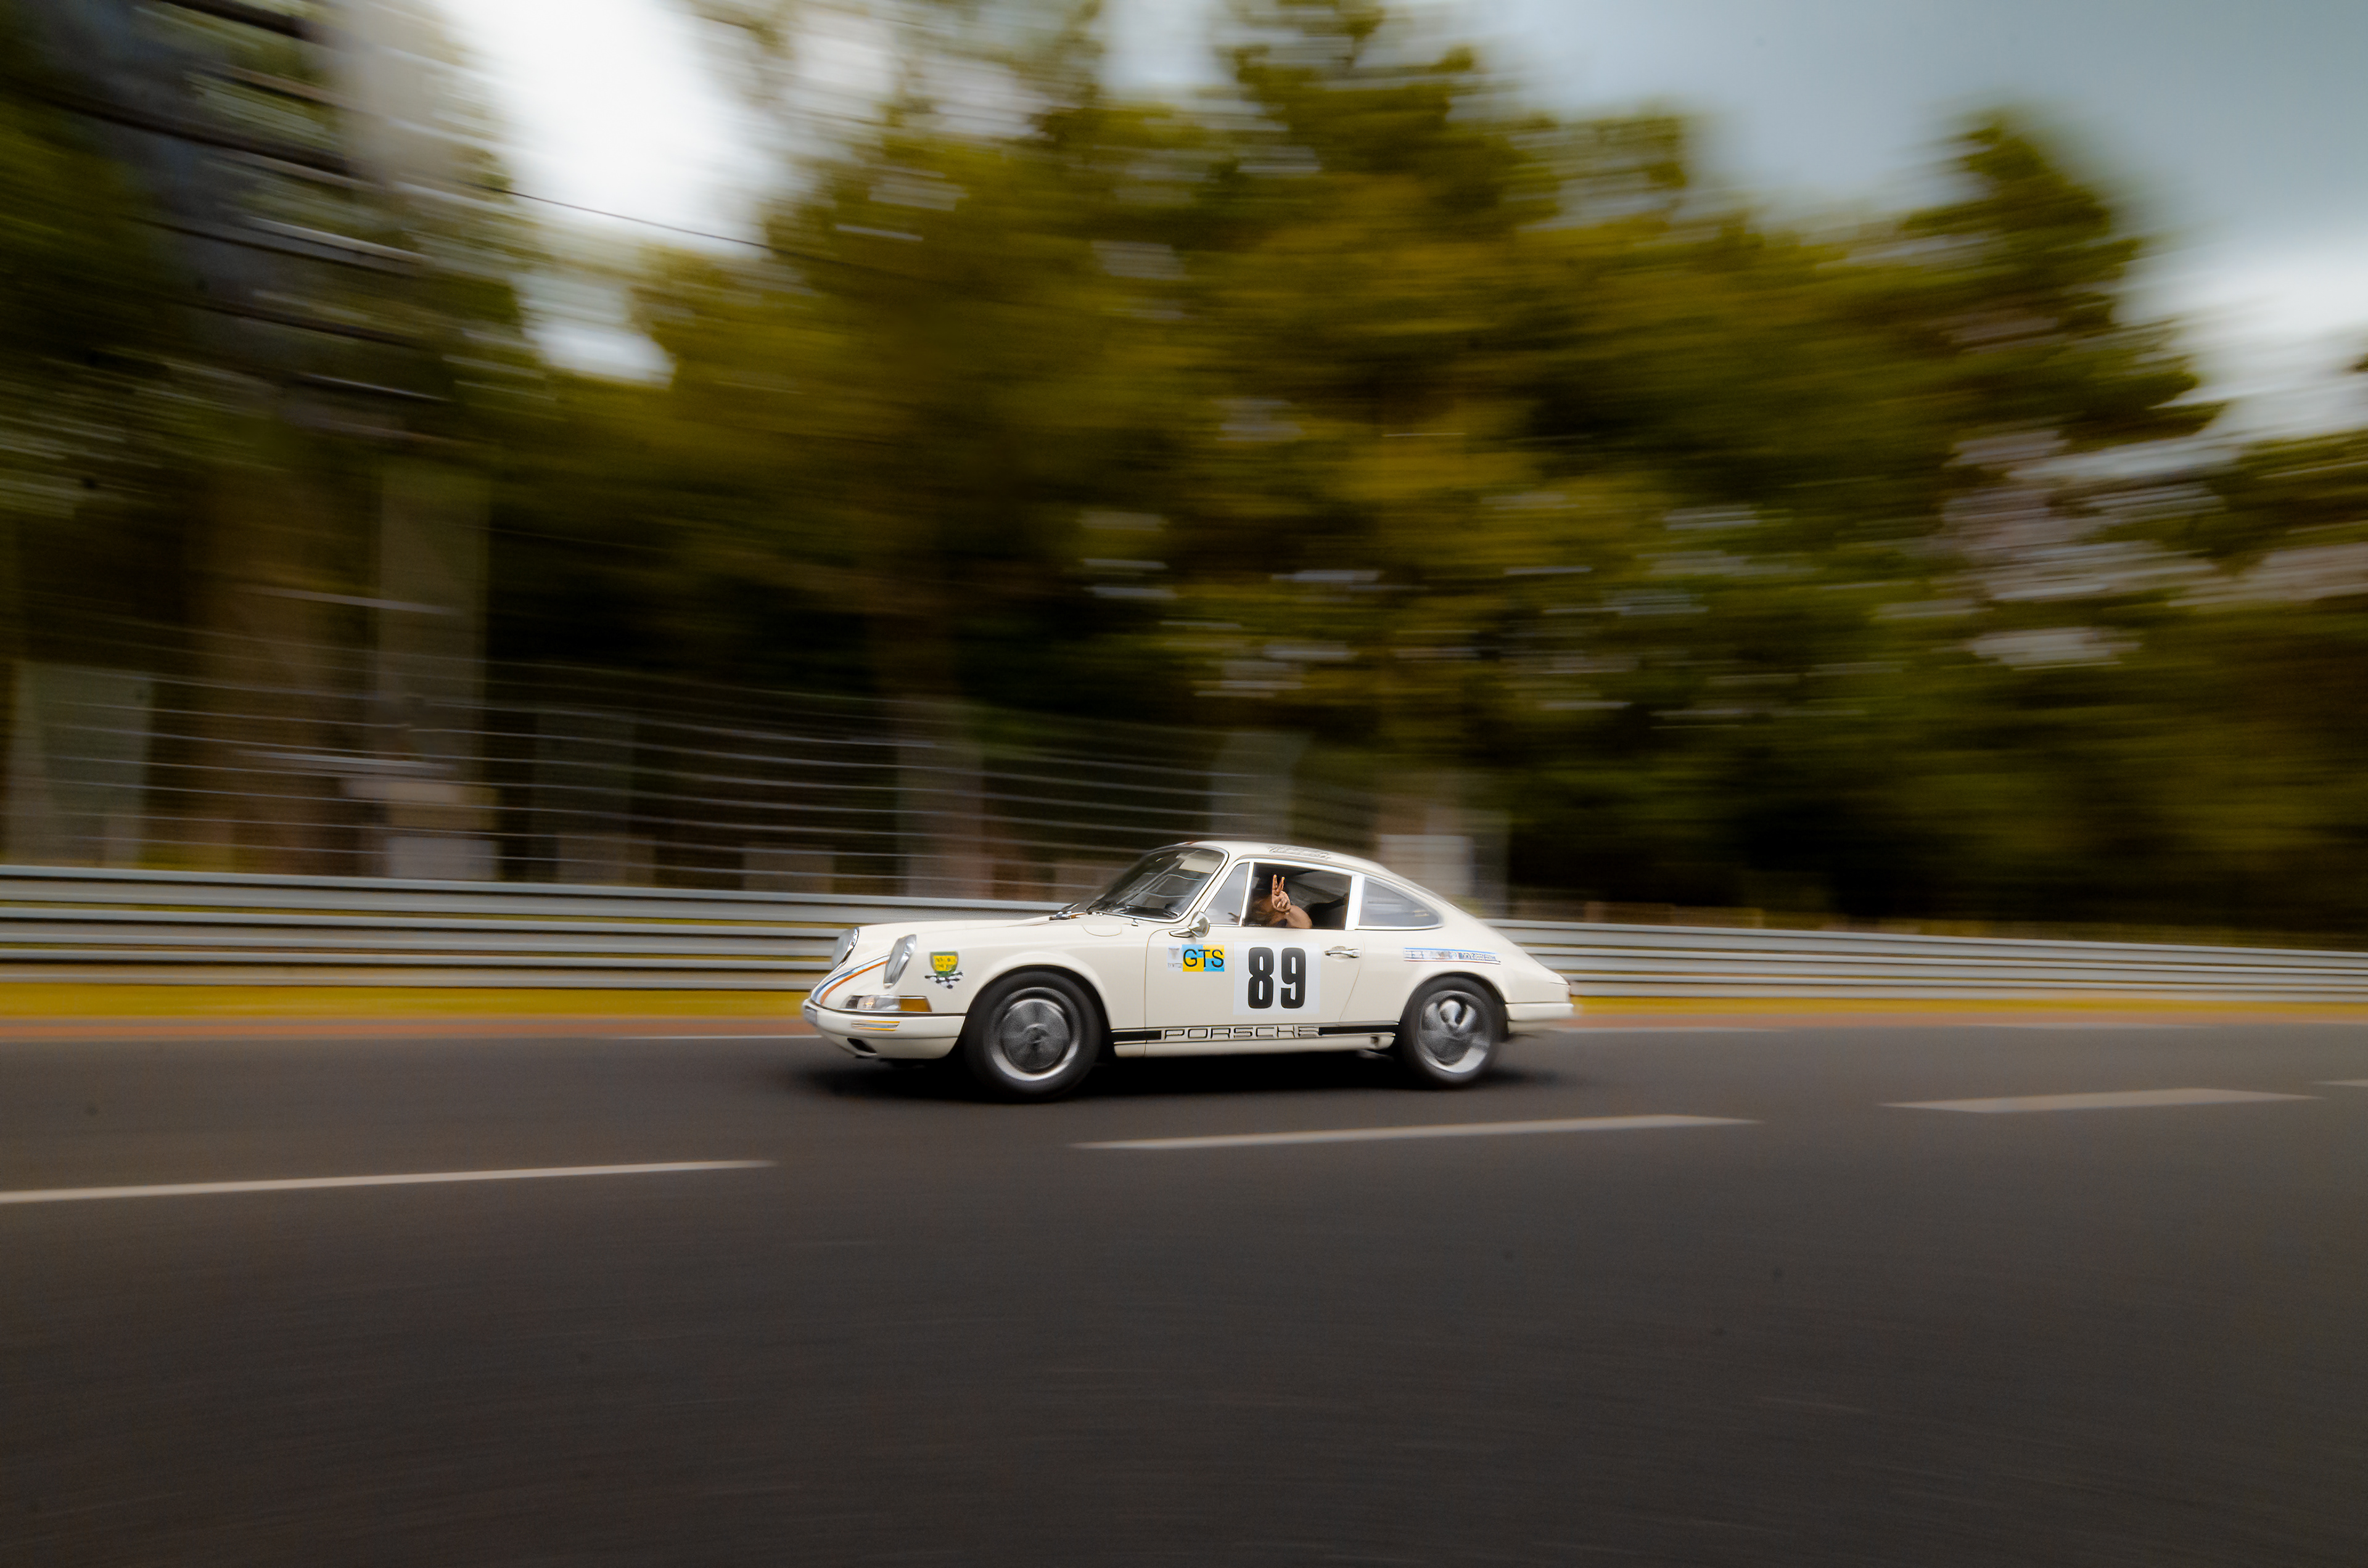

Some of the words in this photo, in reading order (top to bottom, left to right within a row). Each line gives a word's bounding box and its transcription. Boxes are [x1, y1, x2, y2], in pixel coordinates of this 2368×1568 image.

[1183, 948, 1224, 968] GTS
[1248, 947, 1305, 1009] 89
[1164, 1025, 1319, 1040] PORSCHE
